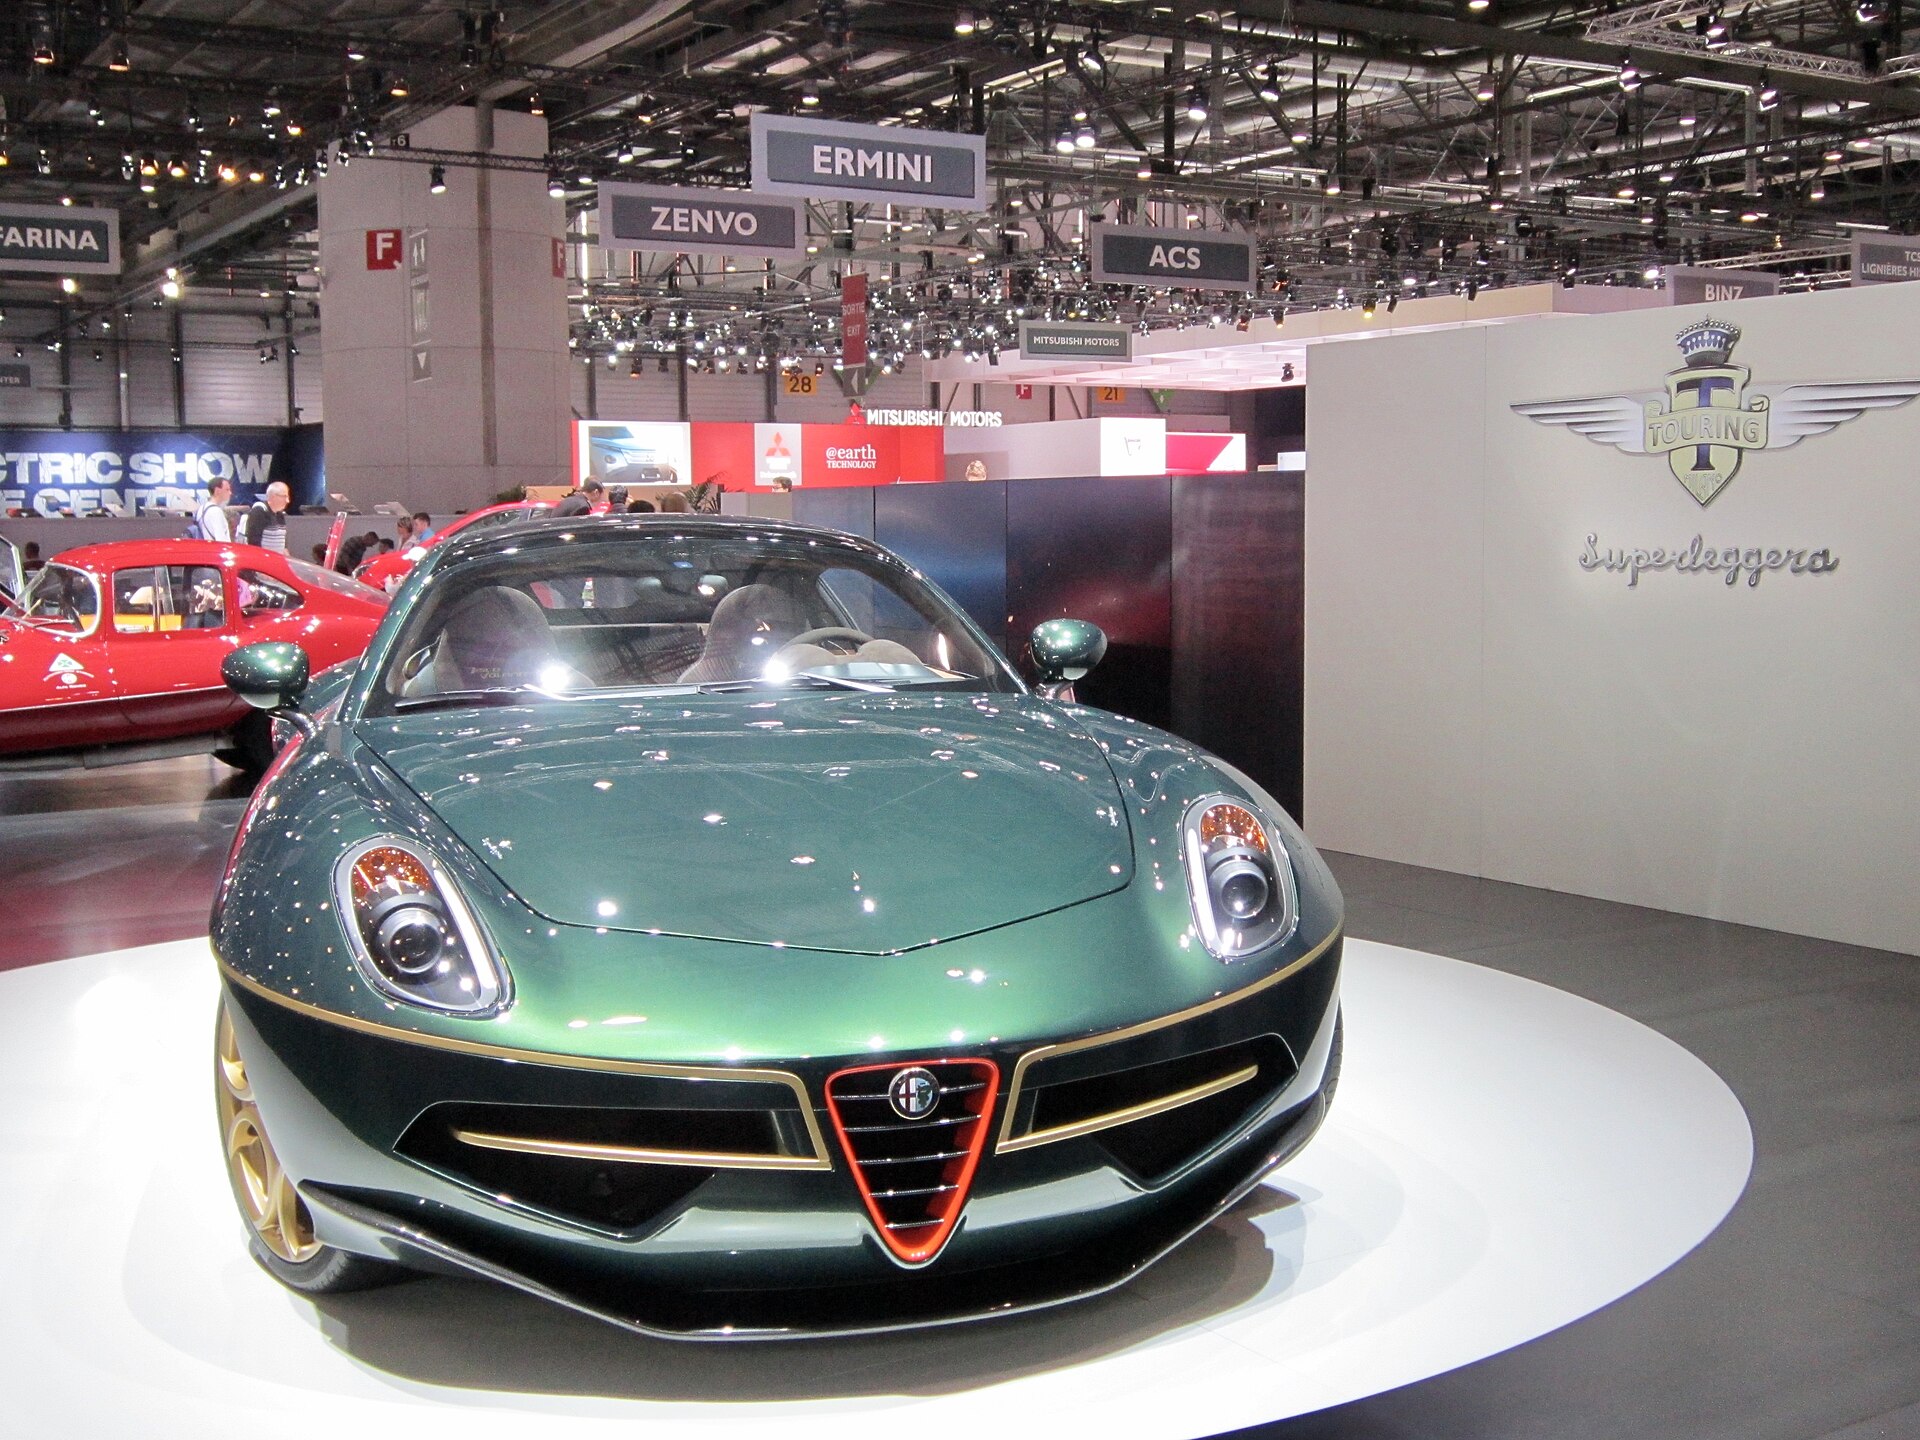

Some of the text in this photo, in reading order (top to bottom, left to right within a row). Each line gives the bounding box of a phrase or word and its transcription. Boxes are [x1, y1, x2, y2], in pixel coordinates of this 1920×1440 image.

[813, 145, 933, 183] ERMINI
[651, 206, 758, 235] ZENVO
[375, 232, 394, 260] F
[1149, 244, 1201, 270] ACS
[1705, 283, 1744, 301] BINZ
[842, 302, 865, 315] SORTIE
[847, 324, 861, 337] EXIT
[1033, 335, 1120, 347] MITSUBISHI MOTORS
[789, 376, 812, 393] 28
[1103, 386, 1118, 401] 21
[866, 408, 1003, 427] MITSUBISHI MOTORS
[1649, 414, 1760, 447] TOURING
[825, 444, 877, 460] @earth
[0, 452, 273, 484] TRIC SHOW
[826, 460, 877, 469] TECHNOLOGY
[1579, 532, 1840, 588] Superleggera
